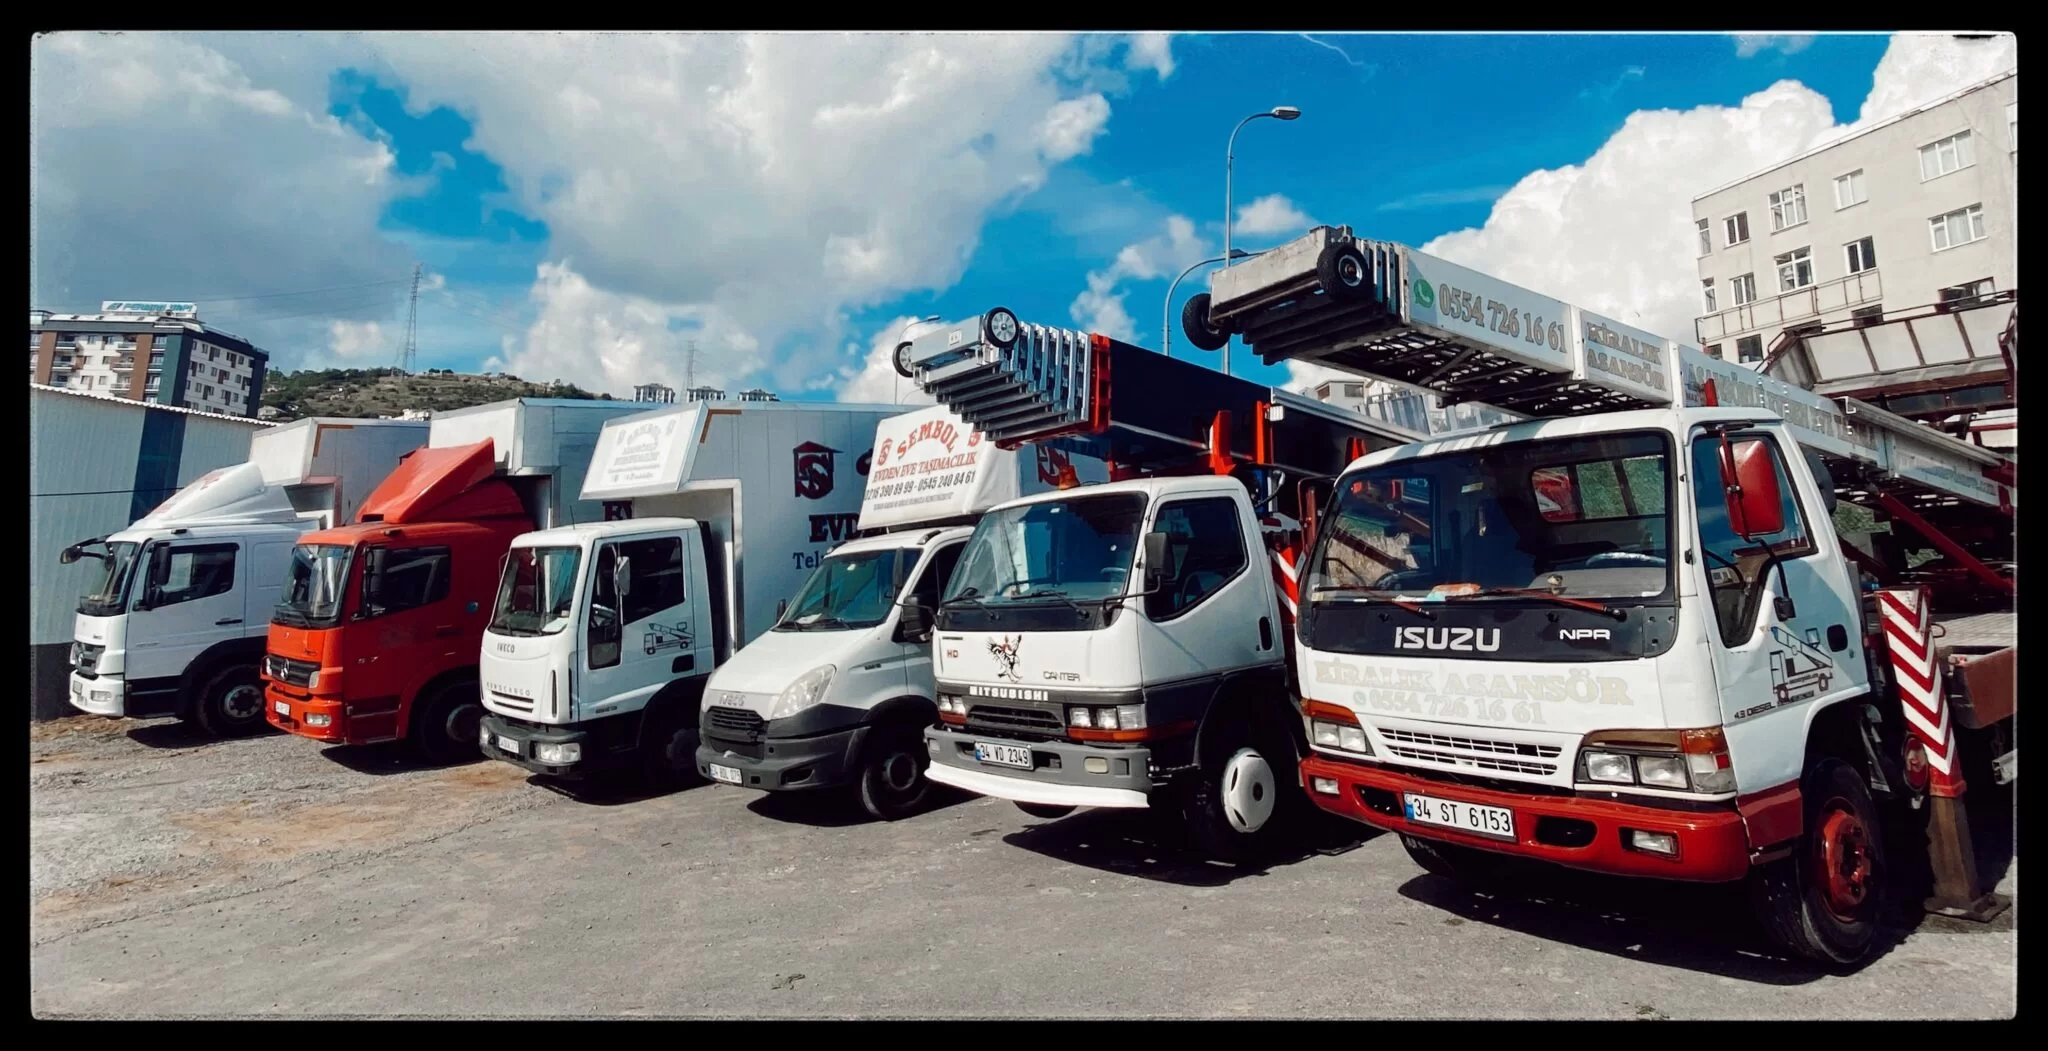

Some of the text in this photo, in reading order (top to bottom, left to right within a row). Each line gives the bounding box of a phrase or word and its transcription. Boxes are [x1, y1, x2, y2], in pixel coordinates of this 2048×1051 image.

[1439, 283, 1567, 353] 0554 726 16 61
[1587, 348, 1667, 392] ASANSÖR
[897, 420, 959, 460] SEMBOL
[872, 452, 977, 483] EVDEN EVE TAŞIMACILIK
[918, 477, 936, 491] 0545
[938, 474, 953, 488] 240
[953, 472, 965, 486] 84
[965, 470, 976, 484] 61
[1395, 627, 1500, 651] ISUZU
[1559, 628, 1611, 640] NPR
[497, 643, 515, 653] IVECO
[947, 650, 958, 658] HD
[1043, 671, 1080, 681] CANTER
[1442, 668, 1634, 706] ASANSÖR
[969, 685, 1049, 702] MITSUBISHI
[1369, 689, 1547, 724] 0554 726 16 61
[1747, 702, 1776, 716] DIESEL
[981, 744, 990, 758] 34
[1008, 748, 1028, 765] 2349
[1414, 798, 1511, 833] 34 ST 6153
